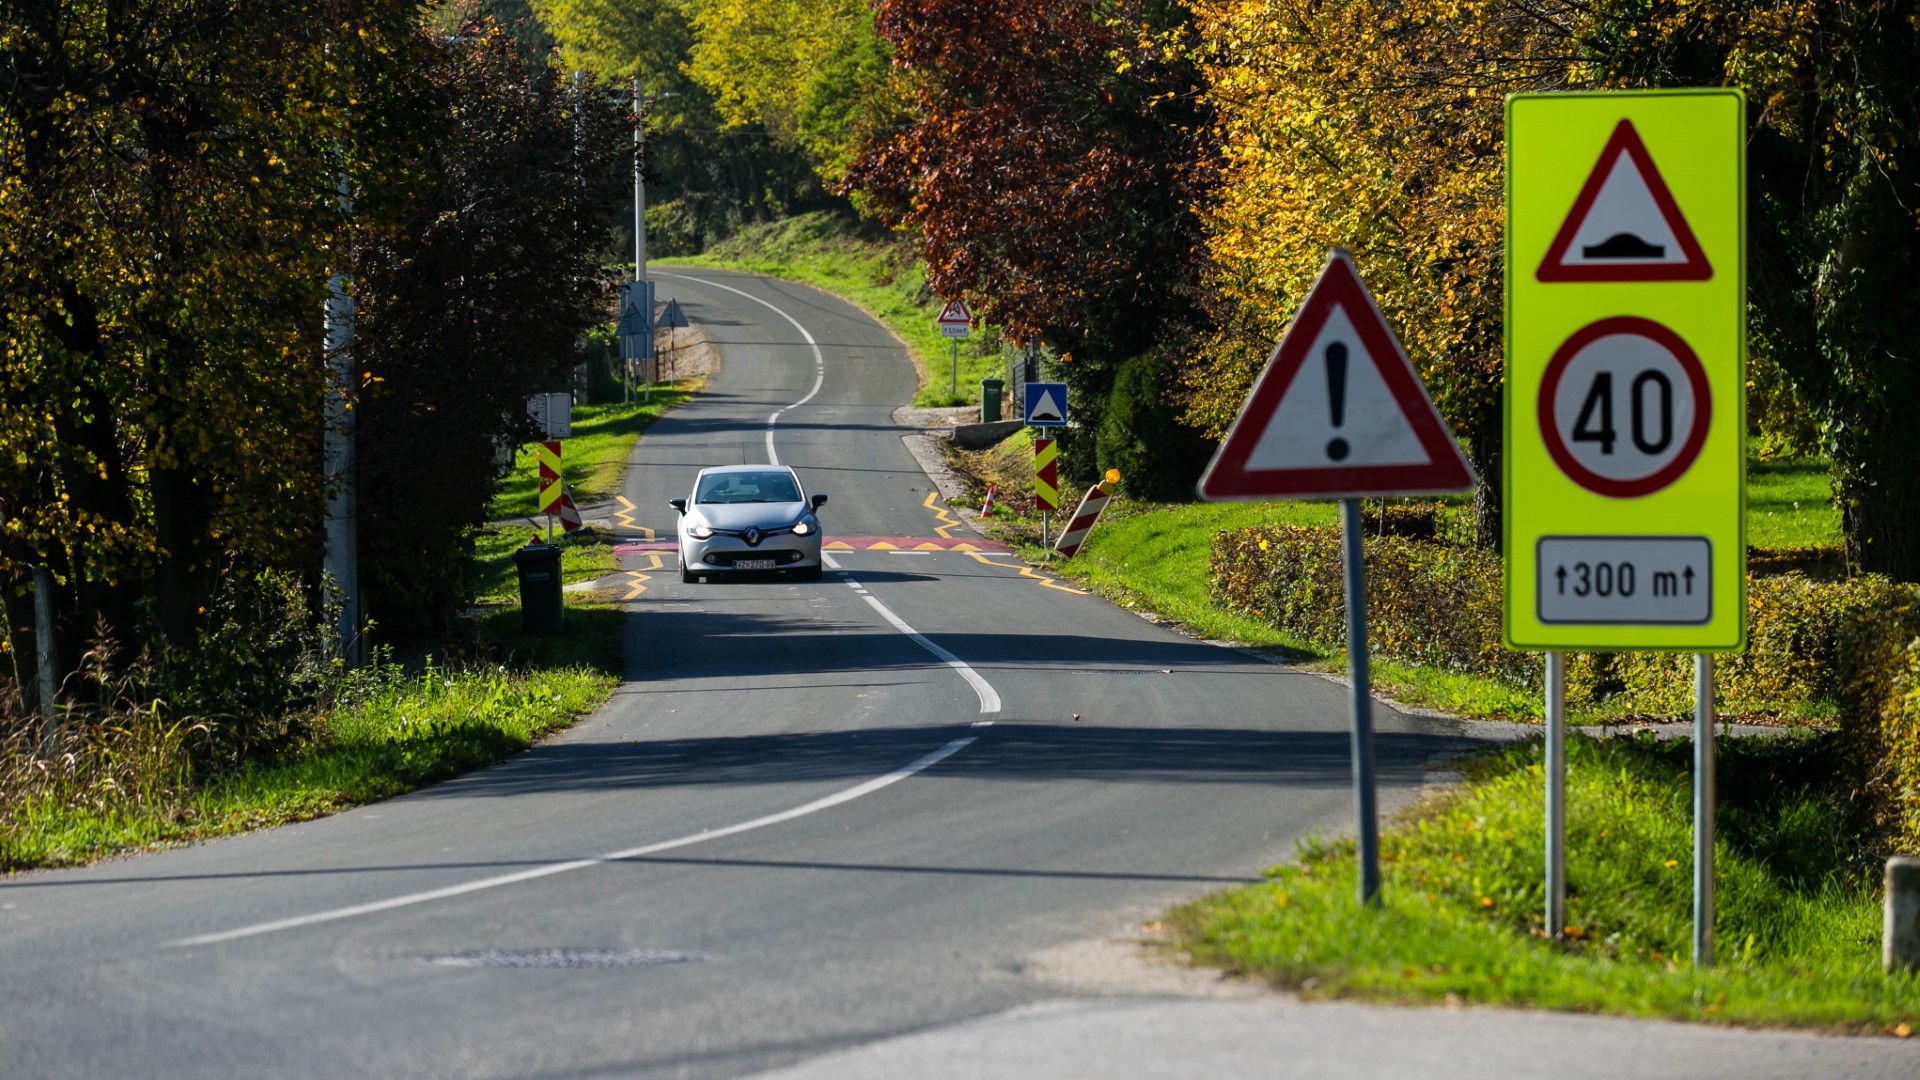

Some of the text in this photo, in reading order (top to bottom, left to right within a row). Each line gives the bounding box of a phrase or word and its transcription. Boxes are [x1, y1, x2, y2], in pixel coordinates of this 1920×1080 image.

[1571, 368, 1673, 456] 40
[1573, 561, 1677, 597] 300 m
